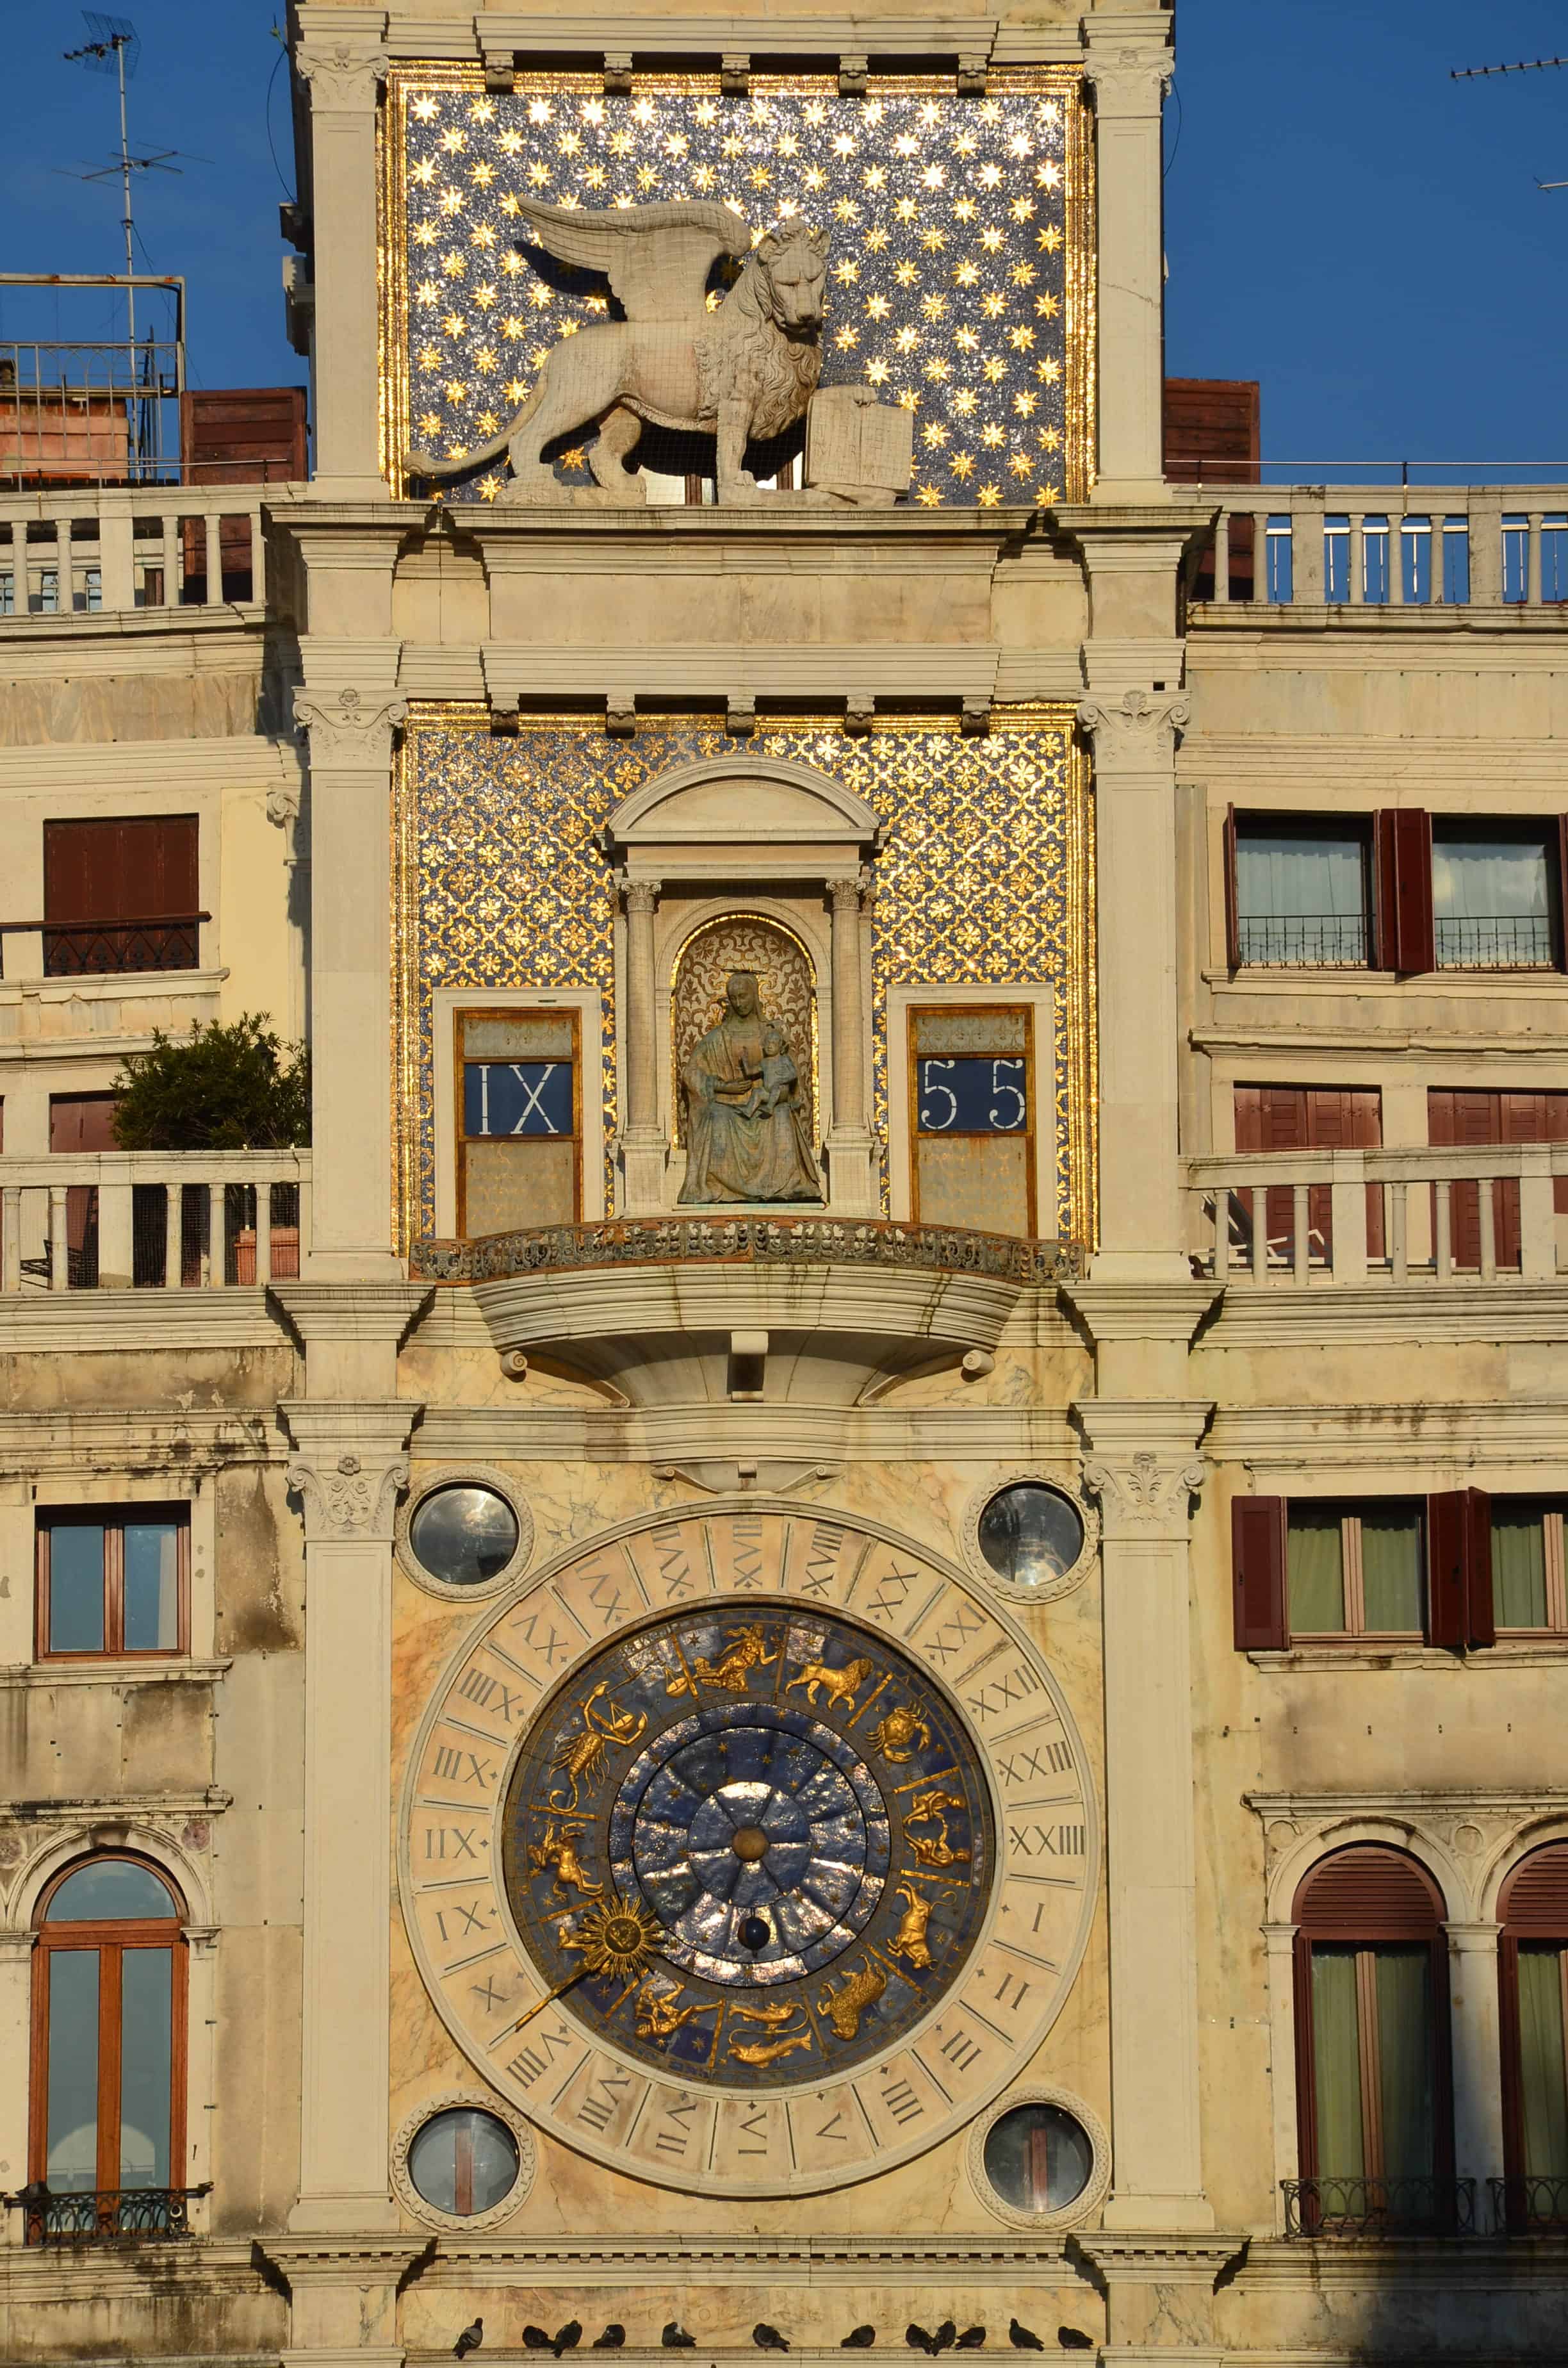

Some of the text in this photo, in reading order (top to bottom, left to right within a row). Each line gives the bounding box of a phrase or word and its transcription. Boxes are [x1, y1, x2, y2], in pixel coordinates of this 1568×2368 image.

[478, 1064, 559, 1135] IX
[574, 1557, 630, 1625] XVI
[867, 1561, 919, 1621] XX
[511, 1614, 569, 1666] XV
[923, 1602, 988, 1666] XXI
[457, 1667, 519, 1723] XIIII
[966, 1664, 1038, 1722] XXII
[432, 1746, 491, 1789] XIII
[995, 1741, 1072, 1787] XXIII
[425, 1828, 477, 1859] XII
[1009, 1825, 1086, 1856] XXIIII
[435, 1901, 491, 1942] XI
[1031, 1903, 1045, 1932] I
[470, 1975, 510, 2013] X
[994, 1973, 1031, 2010] II
[505, 2032, 571, 2089] VIIII
[940, 2030, 983, 2072] III
[578, 2076, 631, 2132] VIII
[881, 2078, 924, 2126] IIII
[656, 2103, 698, 2156] VII
[738, 2112, 767, 2155] VI
[815, 2112, 847, 2142] V
